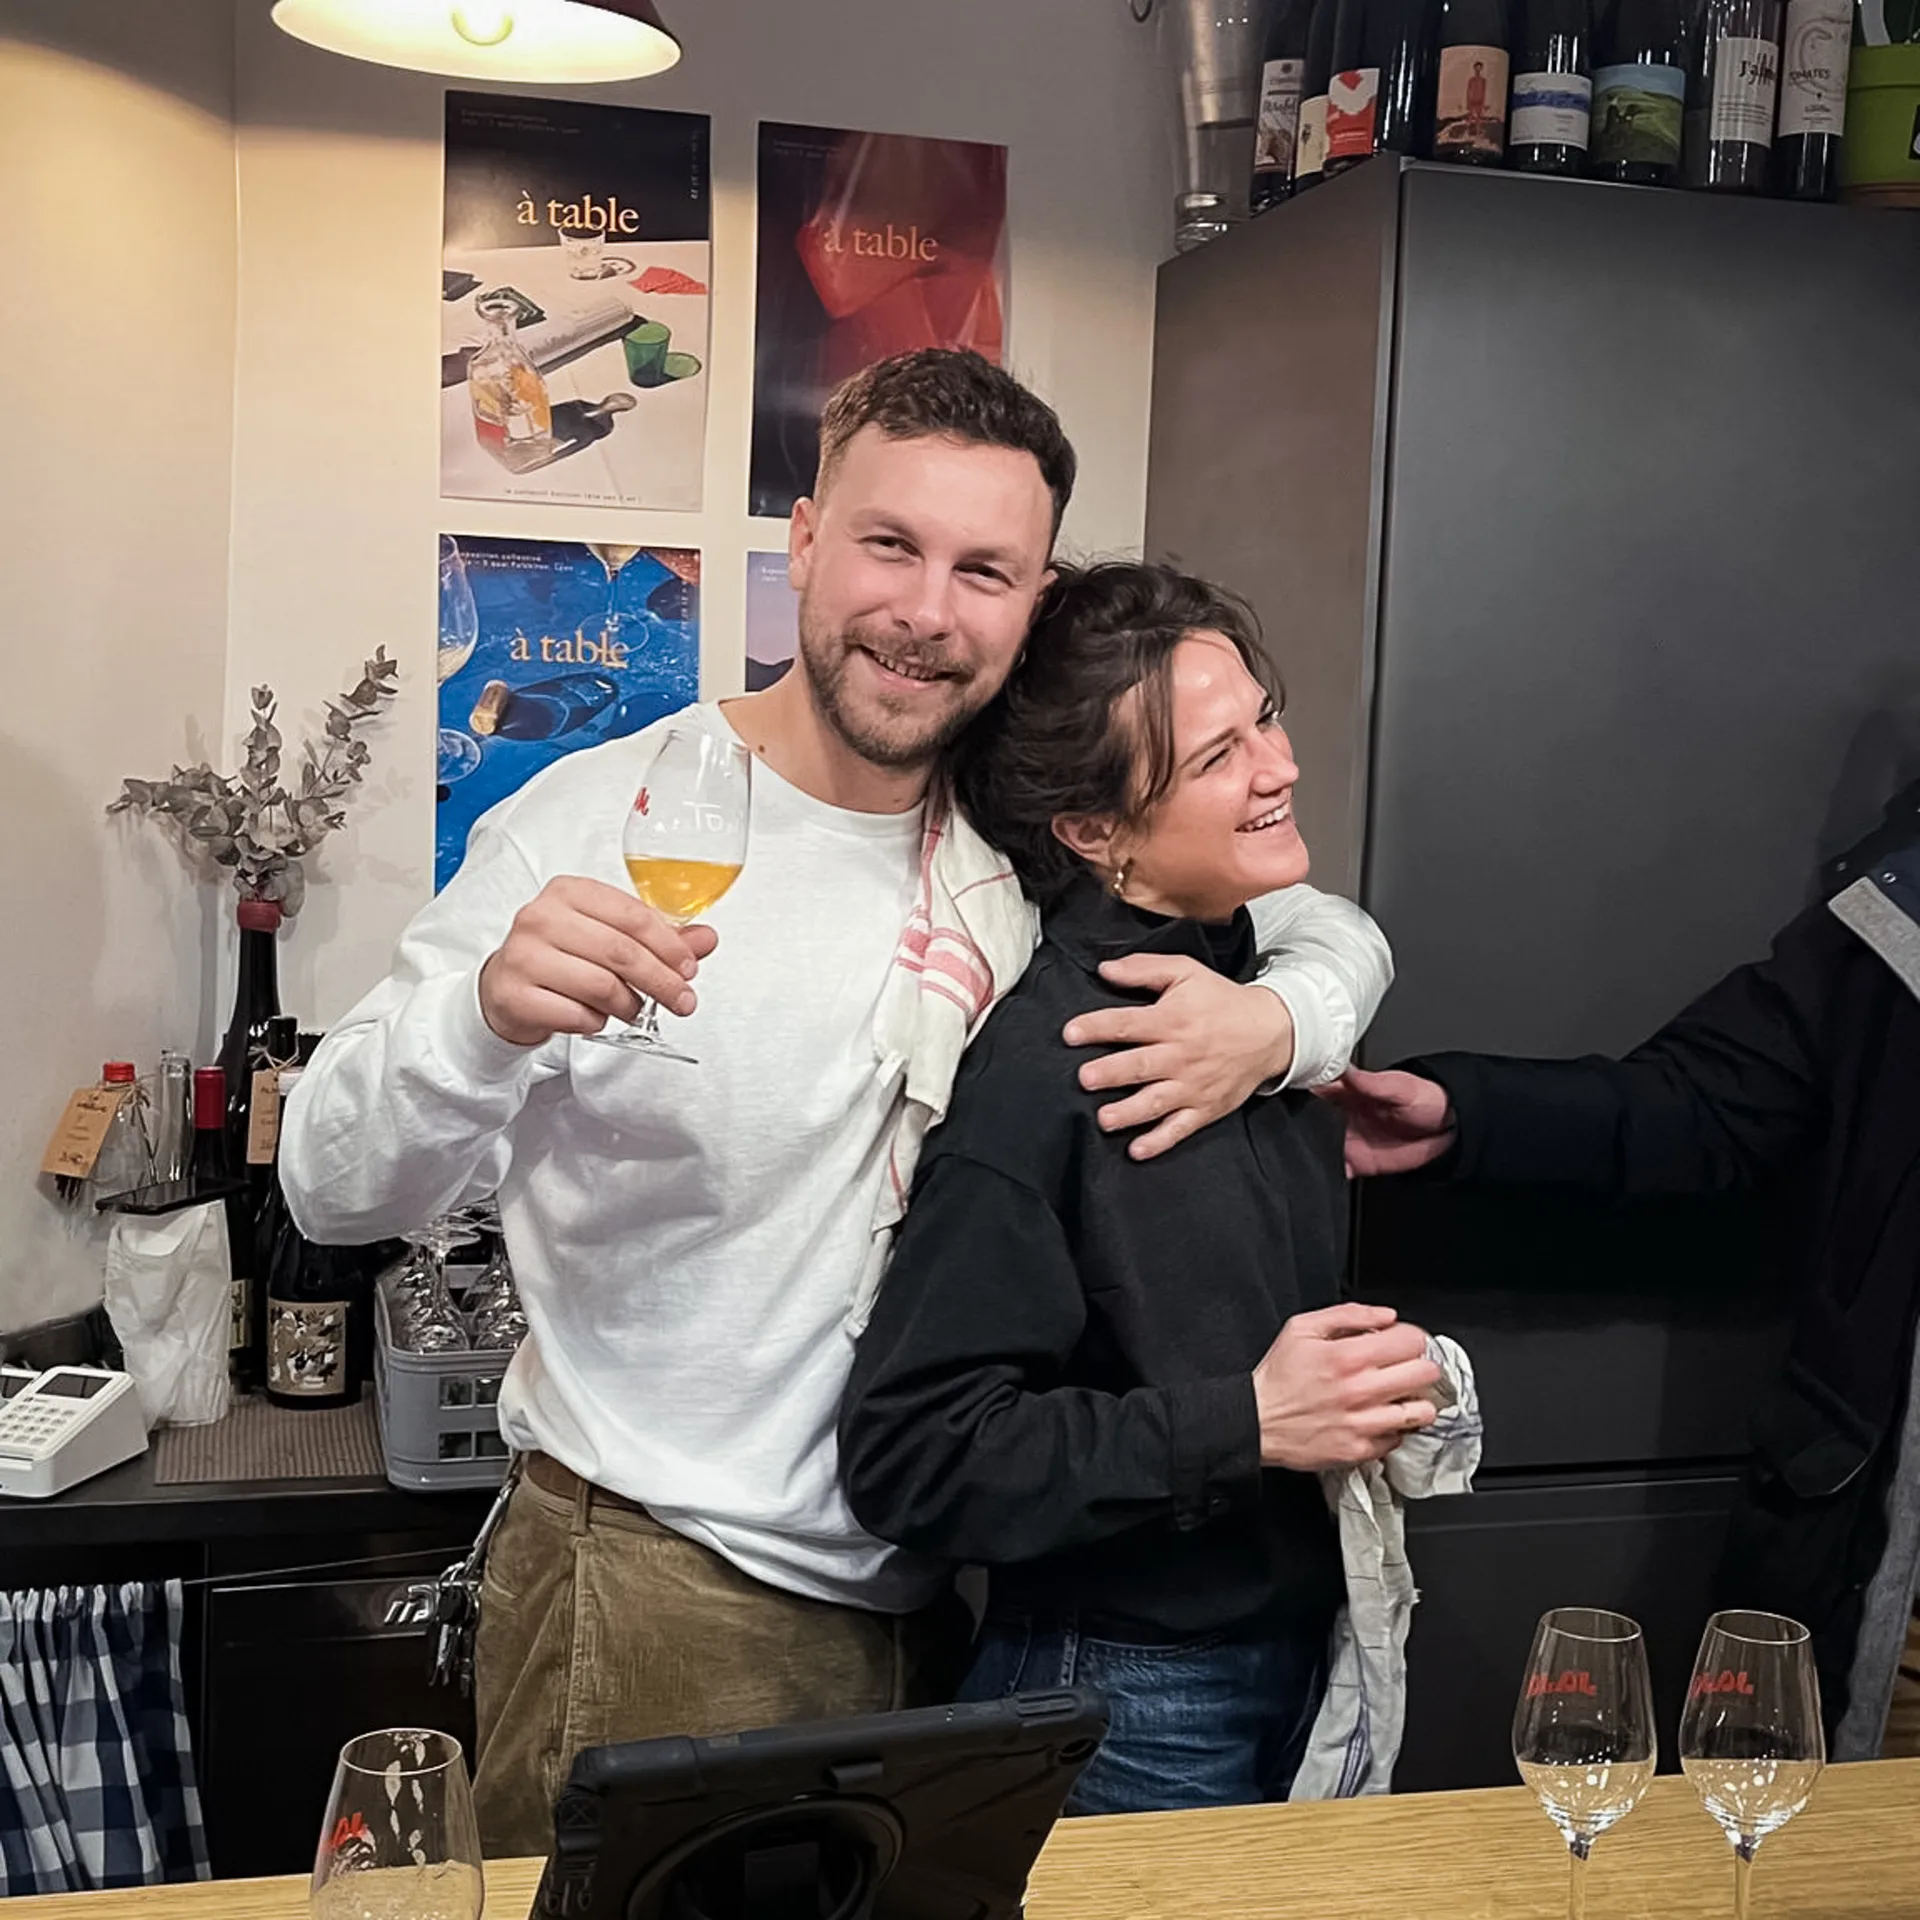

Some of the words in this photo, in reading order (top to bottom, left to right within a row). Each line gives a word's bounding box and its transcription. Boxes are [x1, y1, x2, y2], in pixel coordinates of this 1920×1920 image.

[517, 189, 538, 225] à
[547, 194, 640, 233] table
[853, 224, 939, 262] table
[510, 627, 532, 661] à
[540, 627, 629, 669] table
